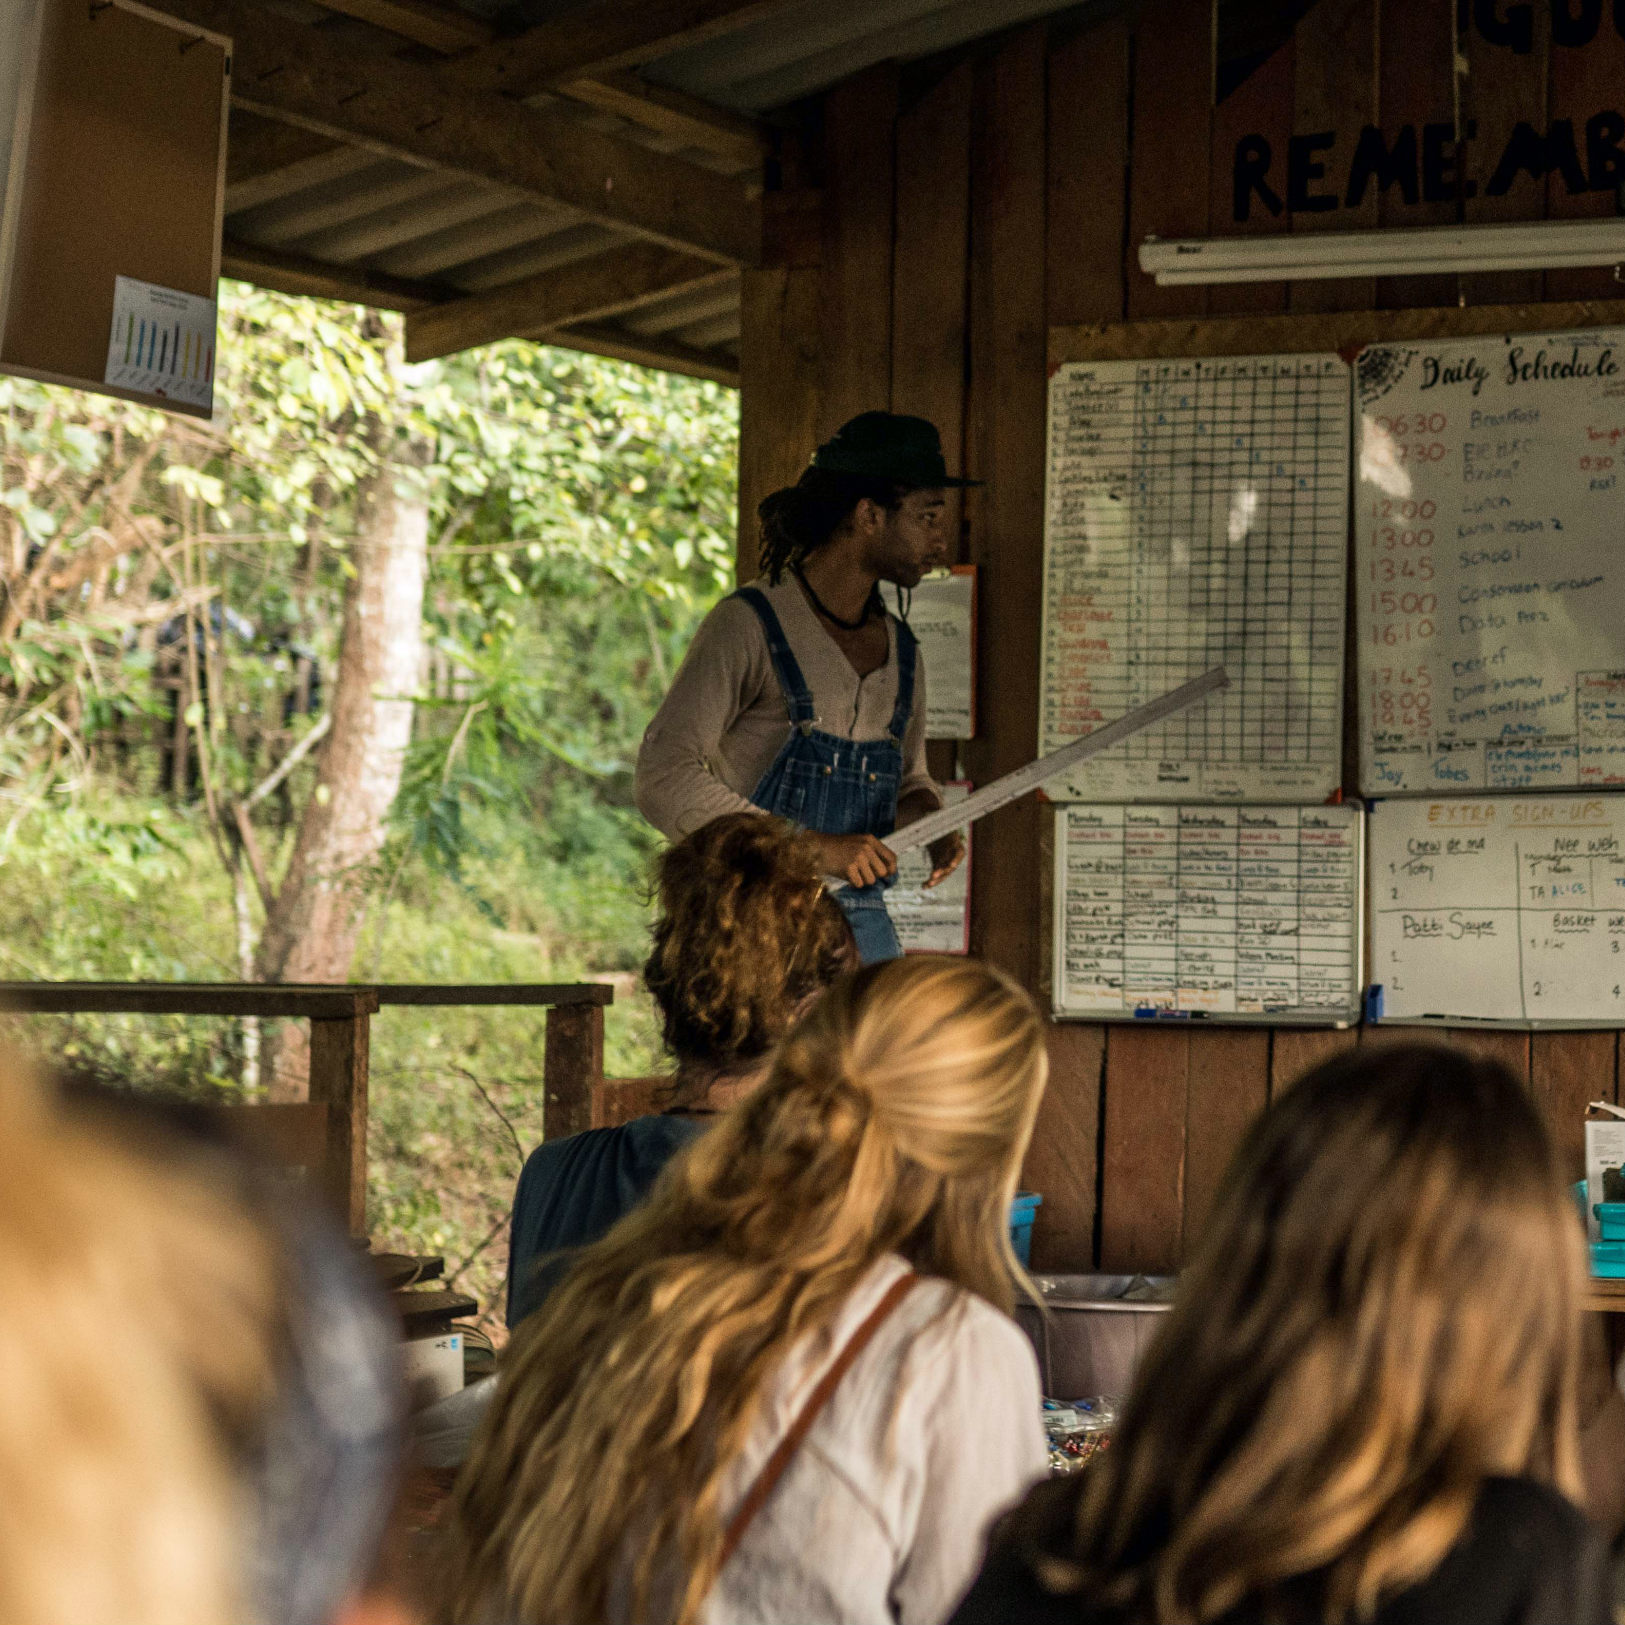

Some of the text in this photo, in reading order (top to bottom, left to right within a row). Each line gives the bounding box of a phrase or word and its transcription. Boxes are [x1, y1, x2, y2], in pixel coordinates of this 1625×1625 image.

[1420, 346, 1619, 396] Daily Schedule
[1427, 804, 1497, 823] EXTRA
